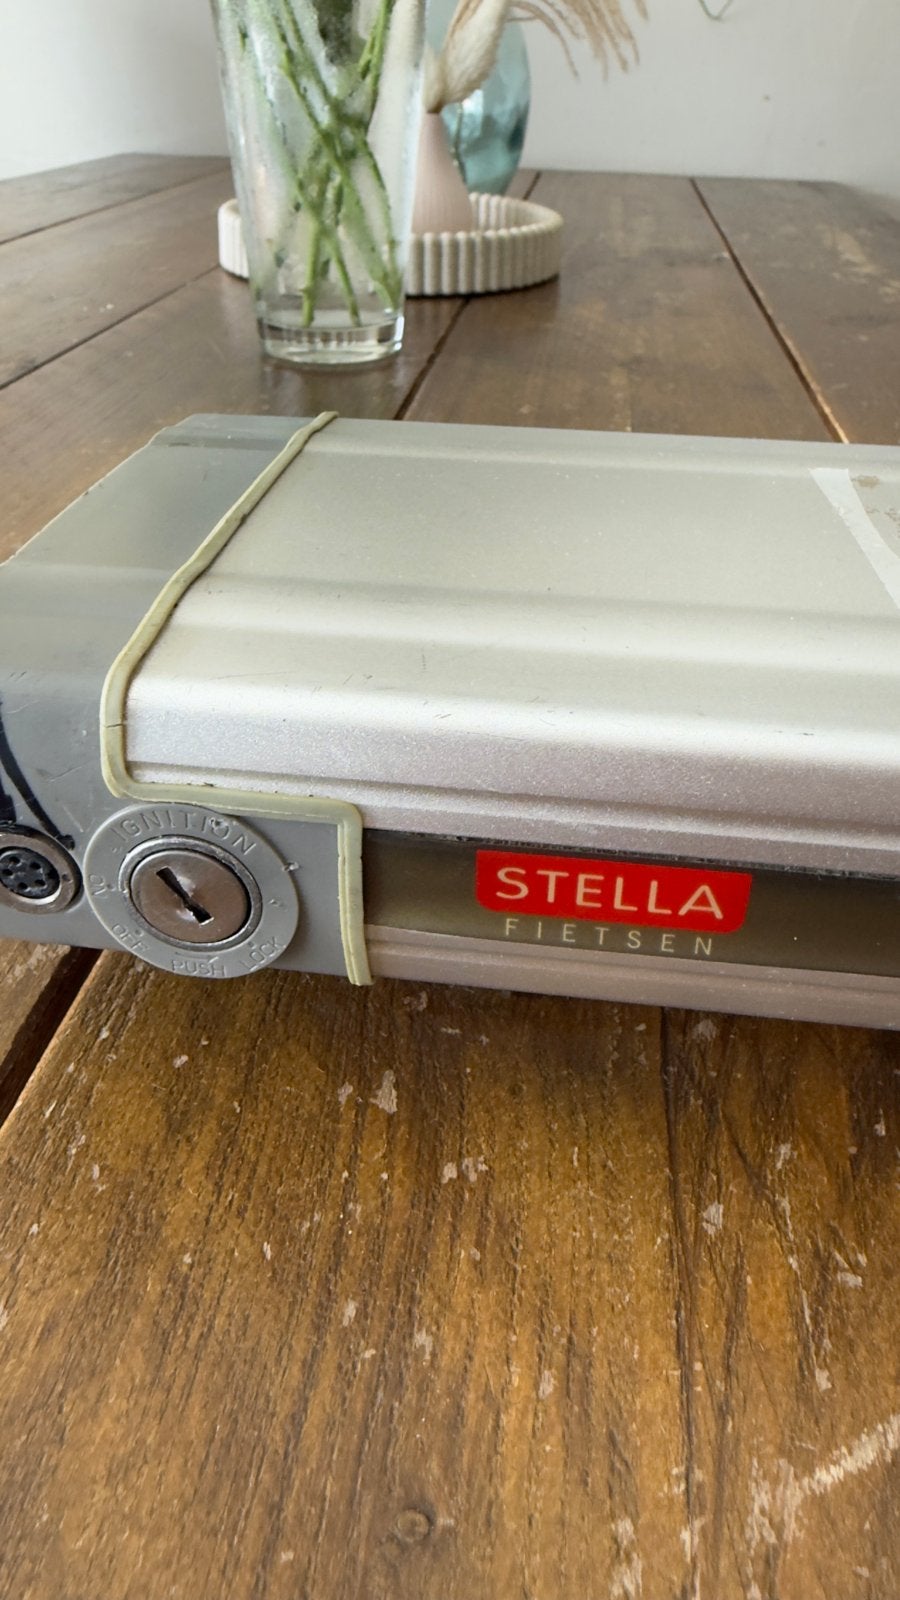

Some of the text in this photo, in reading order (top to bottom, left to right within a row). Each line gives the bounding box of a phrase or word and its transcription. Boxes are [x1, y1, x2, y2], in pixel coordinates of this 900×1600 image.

[110, 810, 256, 856] IGNITION
[496, 867, 723, 920] STELLA
[112, 924, 149, 952] OFF
[241, 936, 284, 972] LOCK
[505, 918, 712, 956] FIETSEN
[171, 959, 225, 977] PUSH
